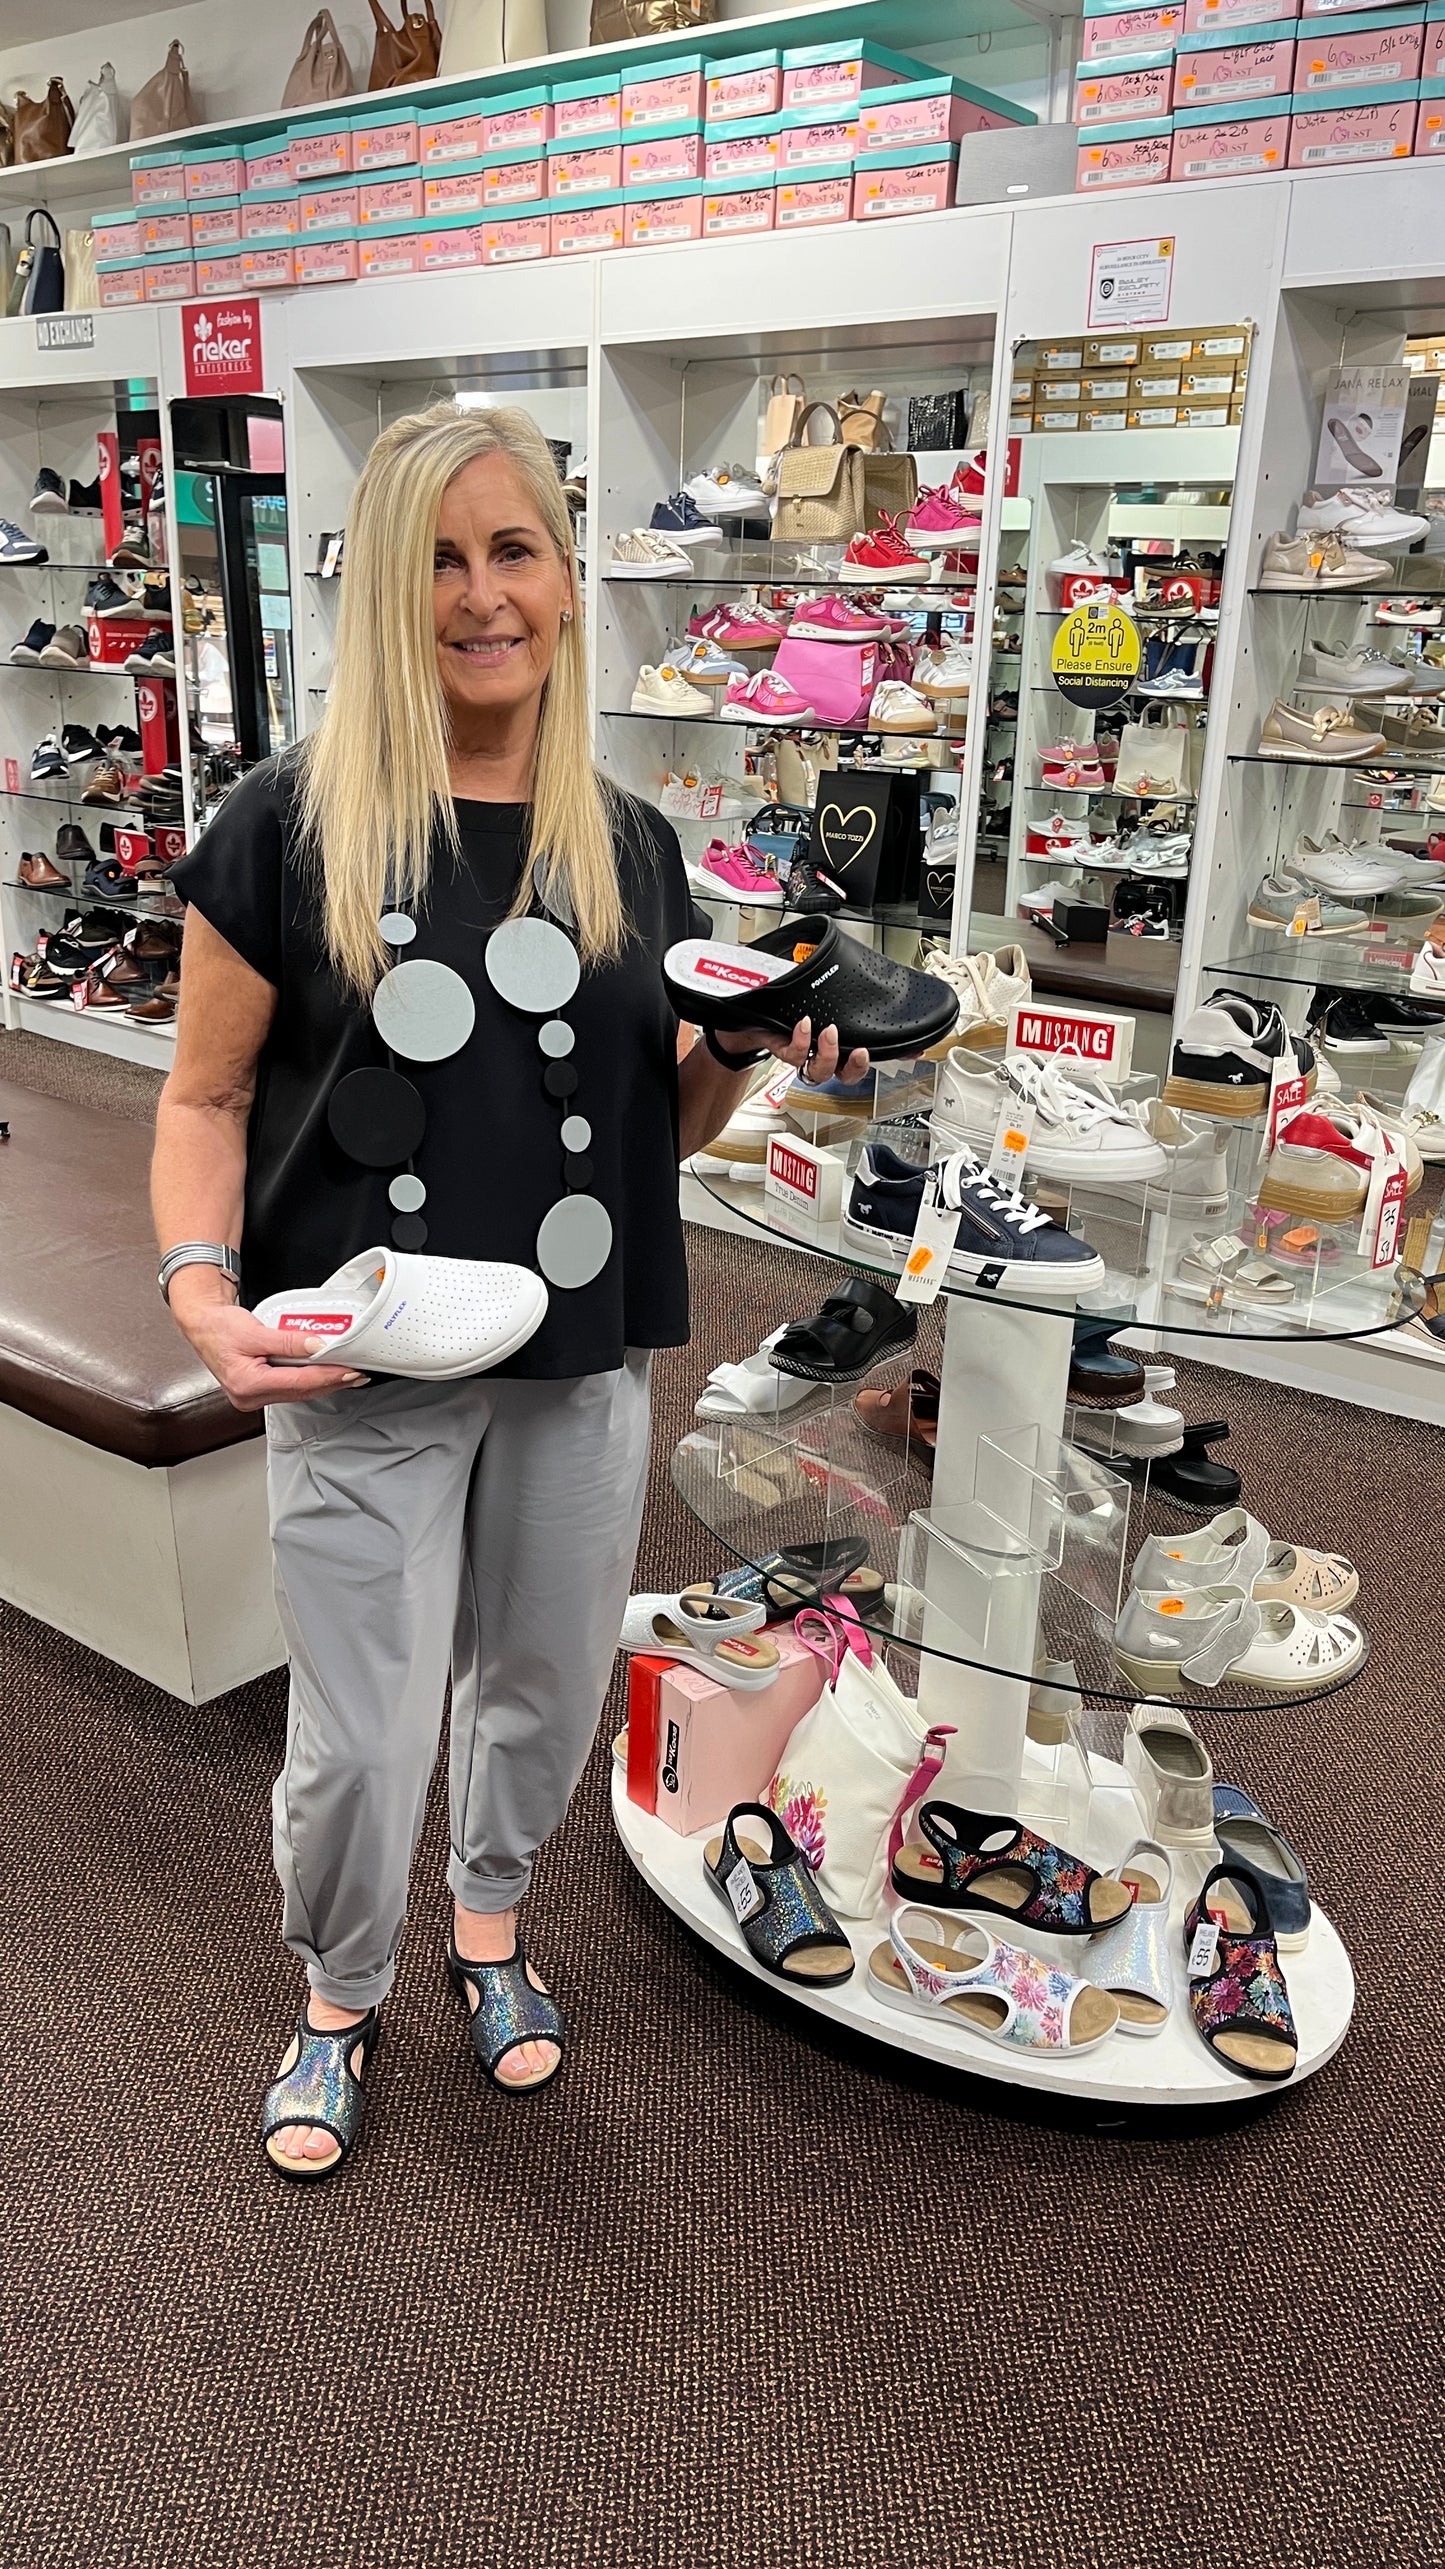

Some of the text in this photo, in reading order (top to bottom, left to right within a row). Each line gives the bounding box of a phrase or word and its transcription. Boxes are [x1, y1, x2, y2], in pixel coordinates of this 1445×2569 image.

[217, 309, 253, 330] fashion by
[192, 332, 252, 362] rieker
[1334, 377, 1404, 390] JANA RELAX
[1087, 622, 1106, 634] 2m
[1056, 658, 1133, 671] Please Ensure
[1058, 675, 1129, 690] Social Distancing
[825, 831, 865, 842] MARCO TOZZI
[1021, 1017, 1108, 1055] MUSTANG
[773, 1147, 814, 1193] MUSTANG
[775, 1181, 809, 1211] True Denim
